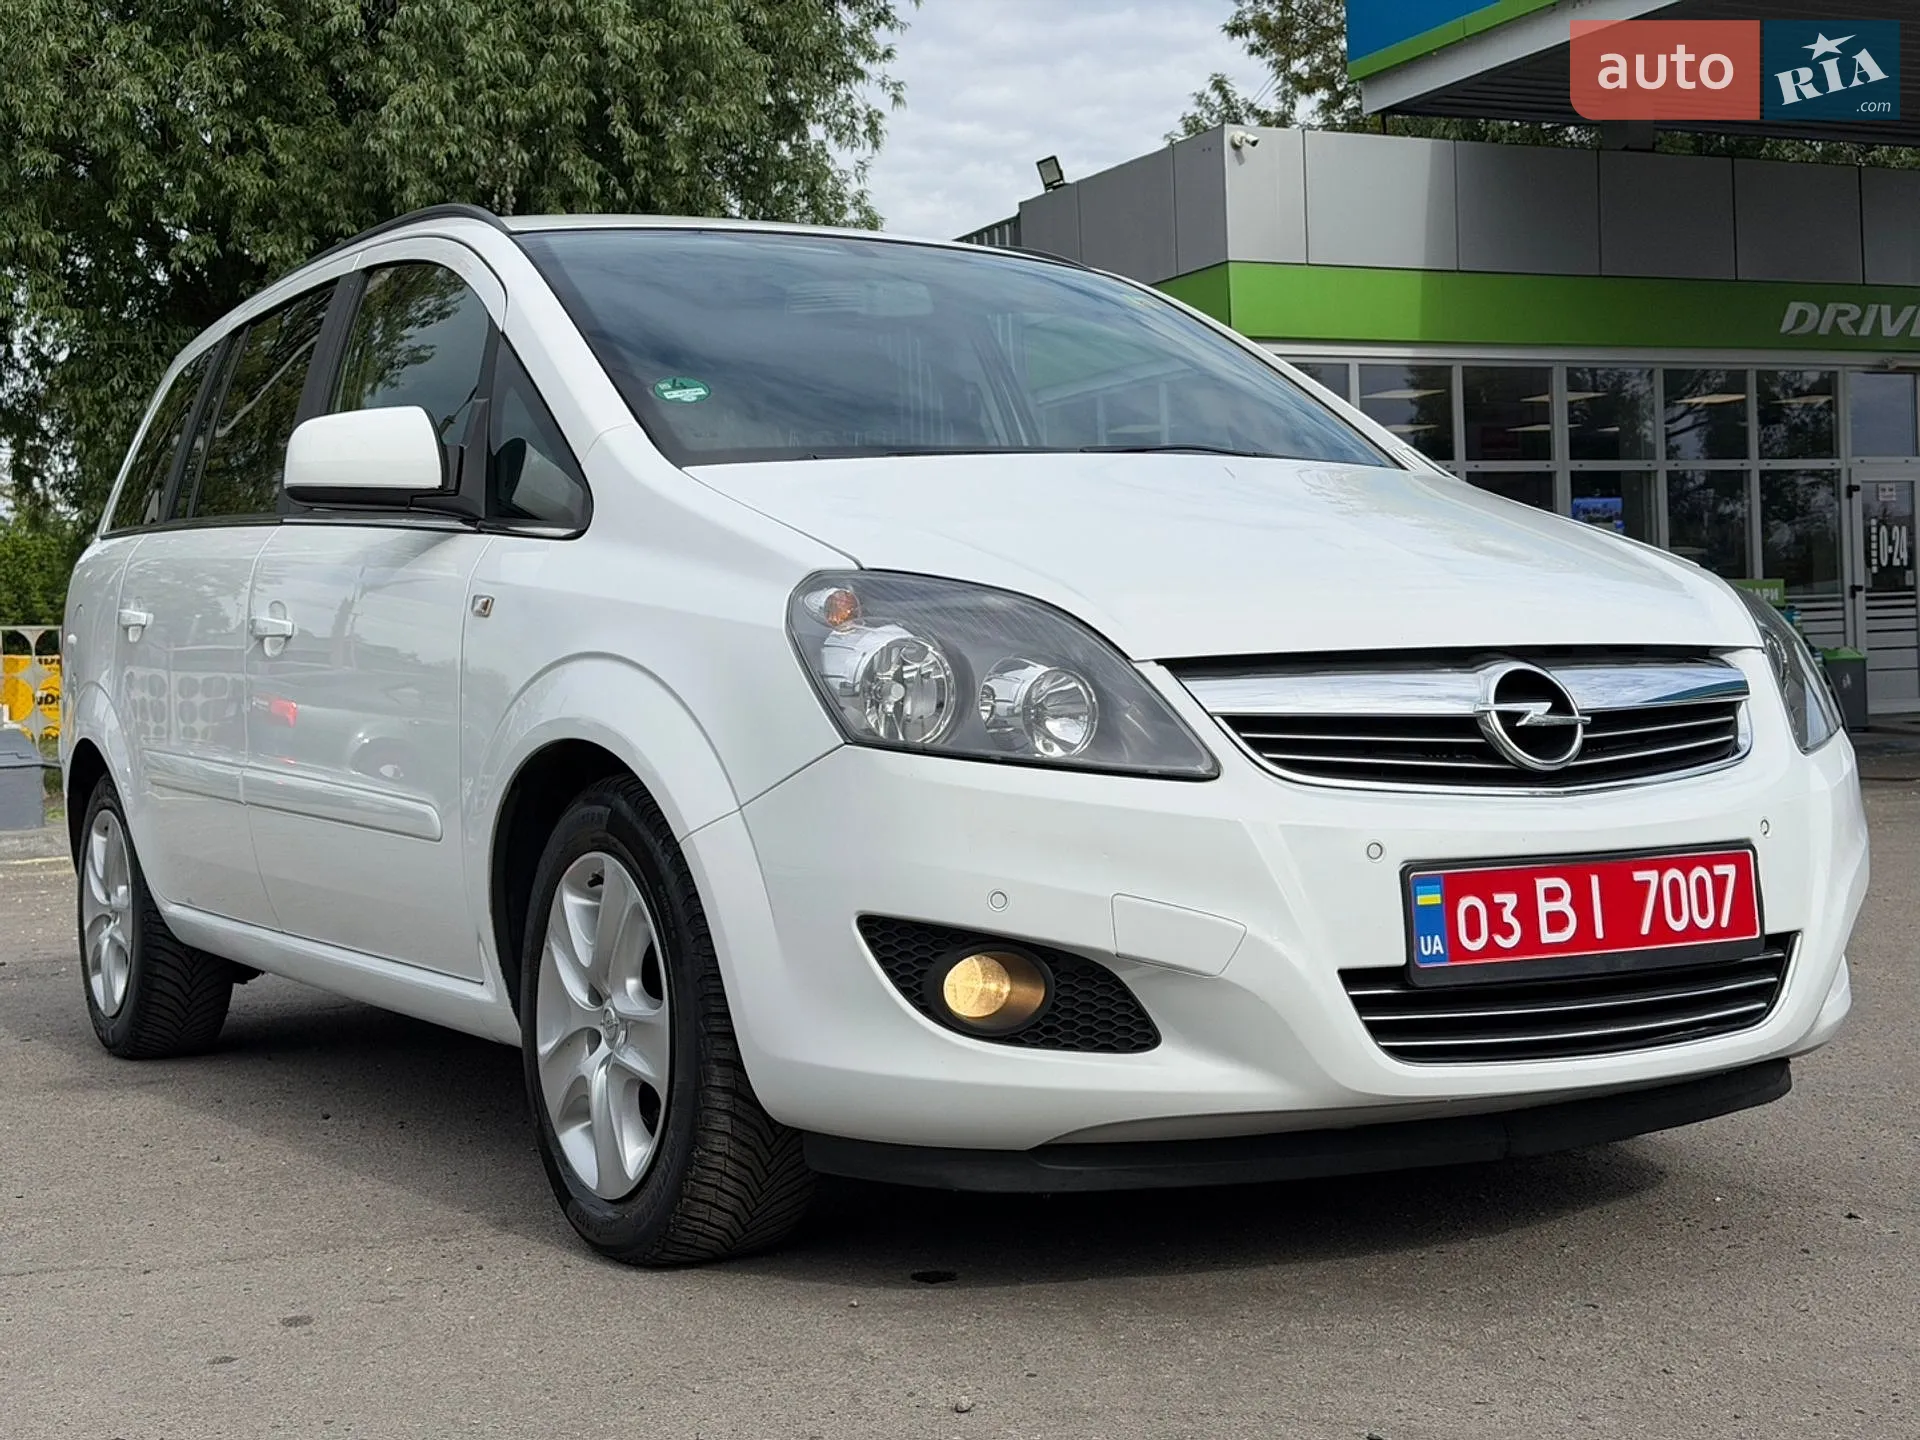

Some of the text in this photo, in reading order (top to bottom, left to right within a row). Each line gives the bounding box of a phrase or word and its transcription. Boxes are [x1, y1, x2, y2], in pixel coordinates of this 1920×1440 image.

[1878, 524, 1909, 568] 0-24
[1456, 892, 1523, 952] 03
[1631, 863, 1737, 937] 7007
[1420, 933, 1444, 957] UA
